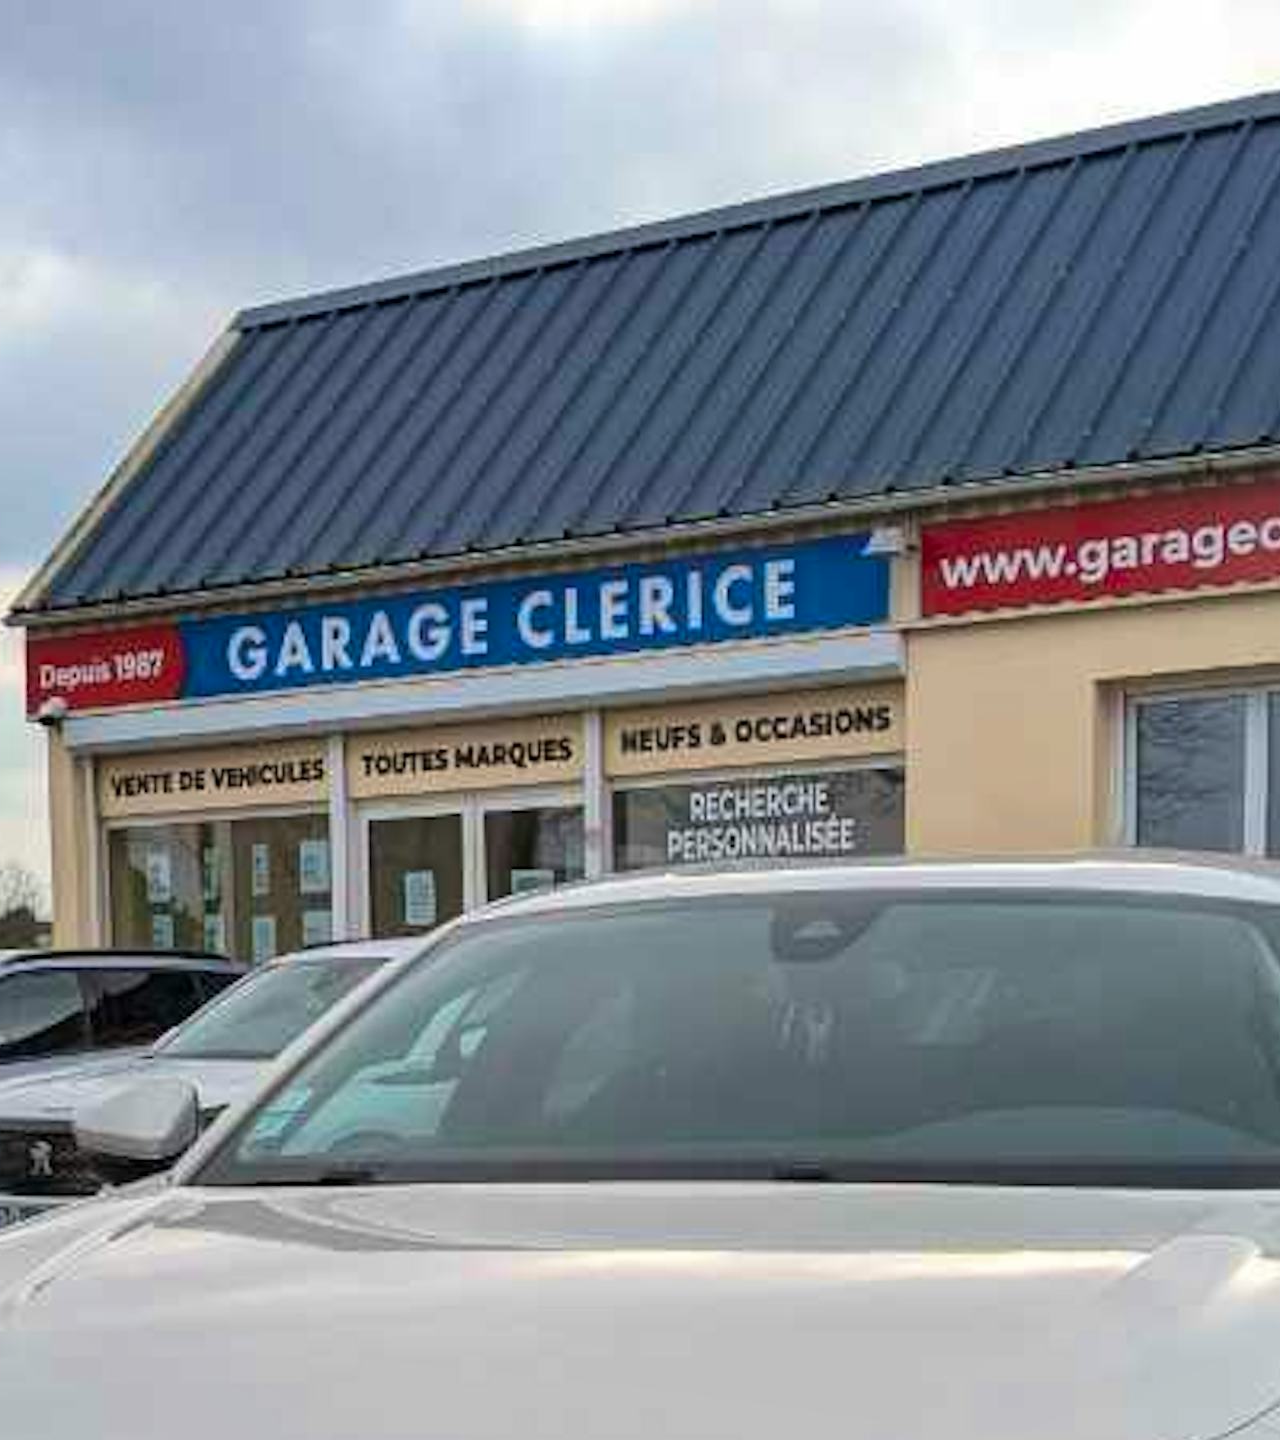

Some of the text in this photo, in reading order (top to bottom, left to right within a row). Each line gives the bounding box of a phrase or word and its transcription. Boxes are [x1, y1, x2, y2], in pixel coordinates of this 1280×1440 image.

[227, 558, 796, 681] GARAGE CLERICE
[39, 648, 164, 692] Depuis 1987
[621, 705, 891, 754] NEUFS & OCCASIONS
[112, 758, 324, 797] VENTE DE VEHICULES
[362, 737, 573, 777] TOUTES MARQUES
[690, 782, 830, 822] RECHERCHE
[668, 815, 856, 859] PERSONNALISÉE
